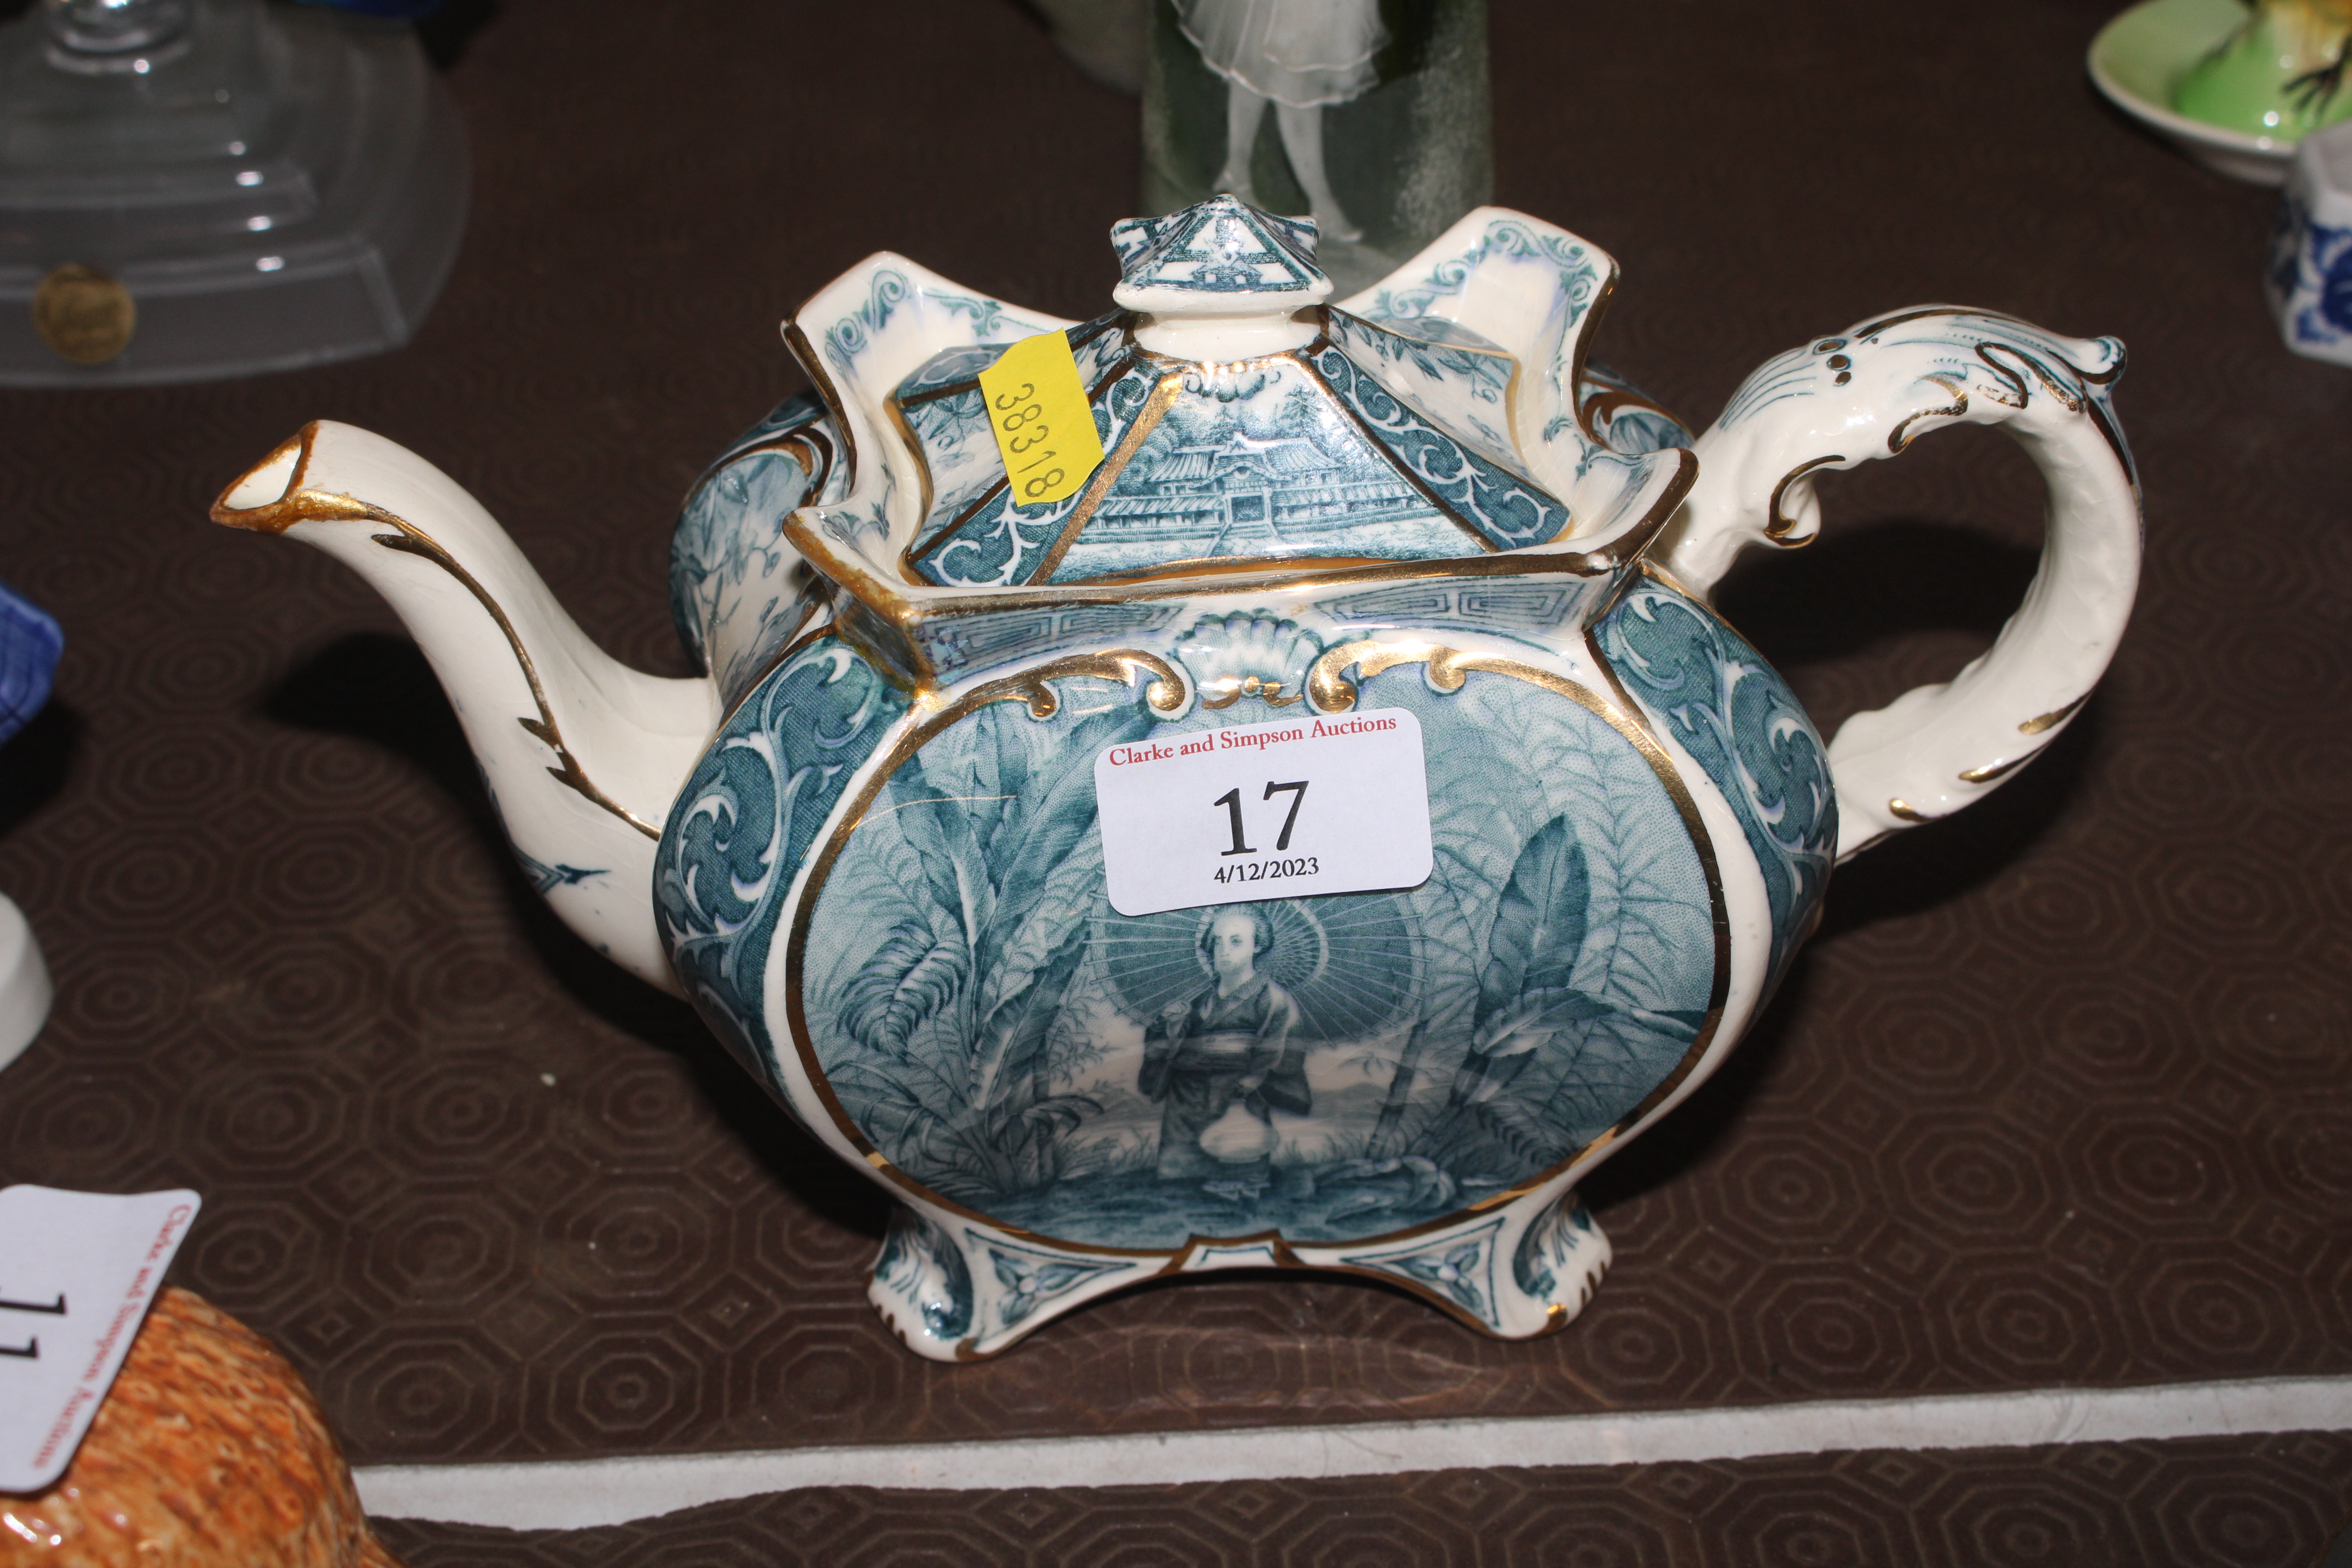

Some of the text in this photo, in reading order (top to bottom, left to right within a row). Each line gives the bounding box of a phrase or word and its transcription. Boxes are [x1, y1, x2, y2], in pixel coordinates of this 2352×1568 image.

[995, 383, 1065, 497] 38318
[1109, 717, 1397, 766] Clarke and Simpson Auctions
[1213, 780, 1310, 856] 17
[1214, 857, 1319, 884] 4/12/2023
[147, 1205, 191, 1261] Clarke
